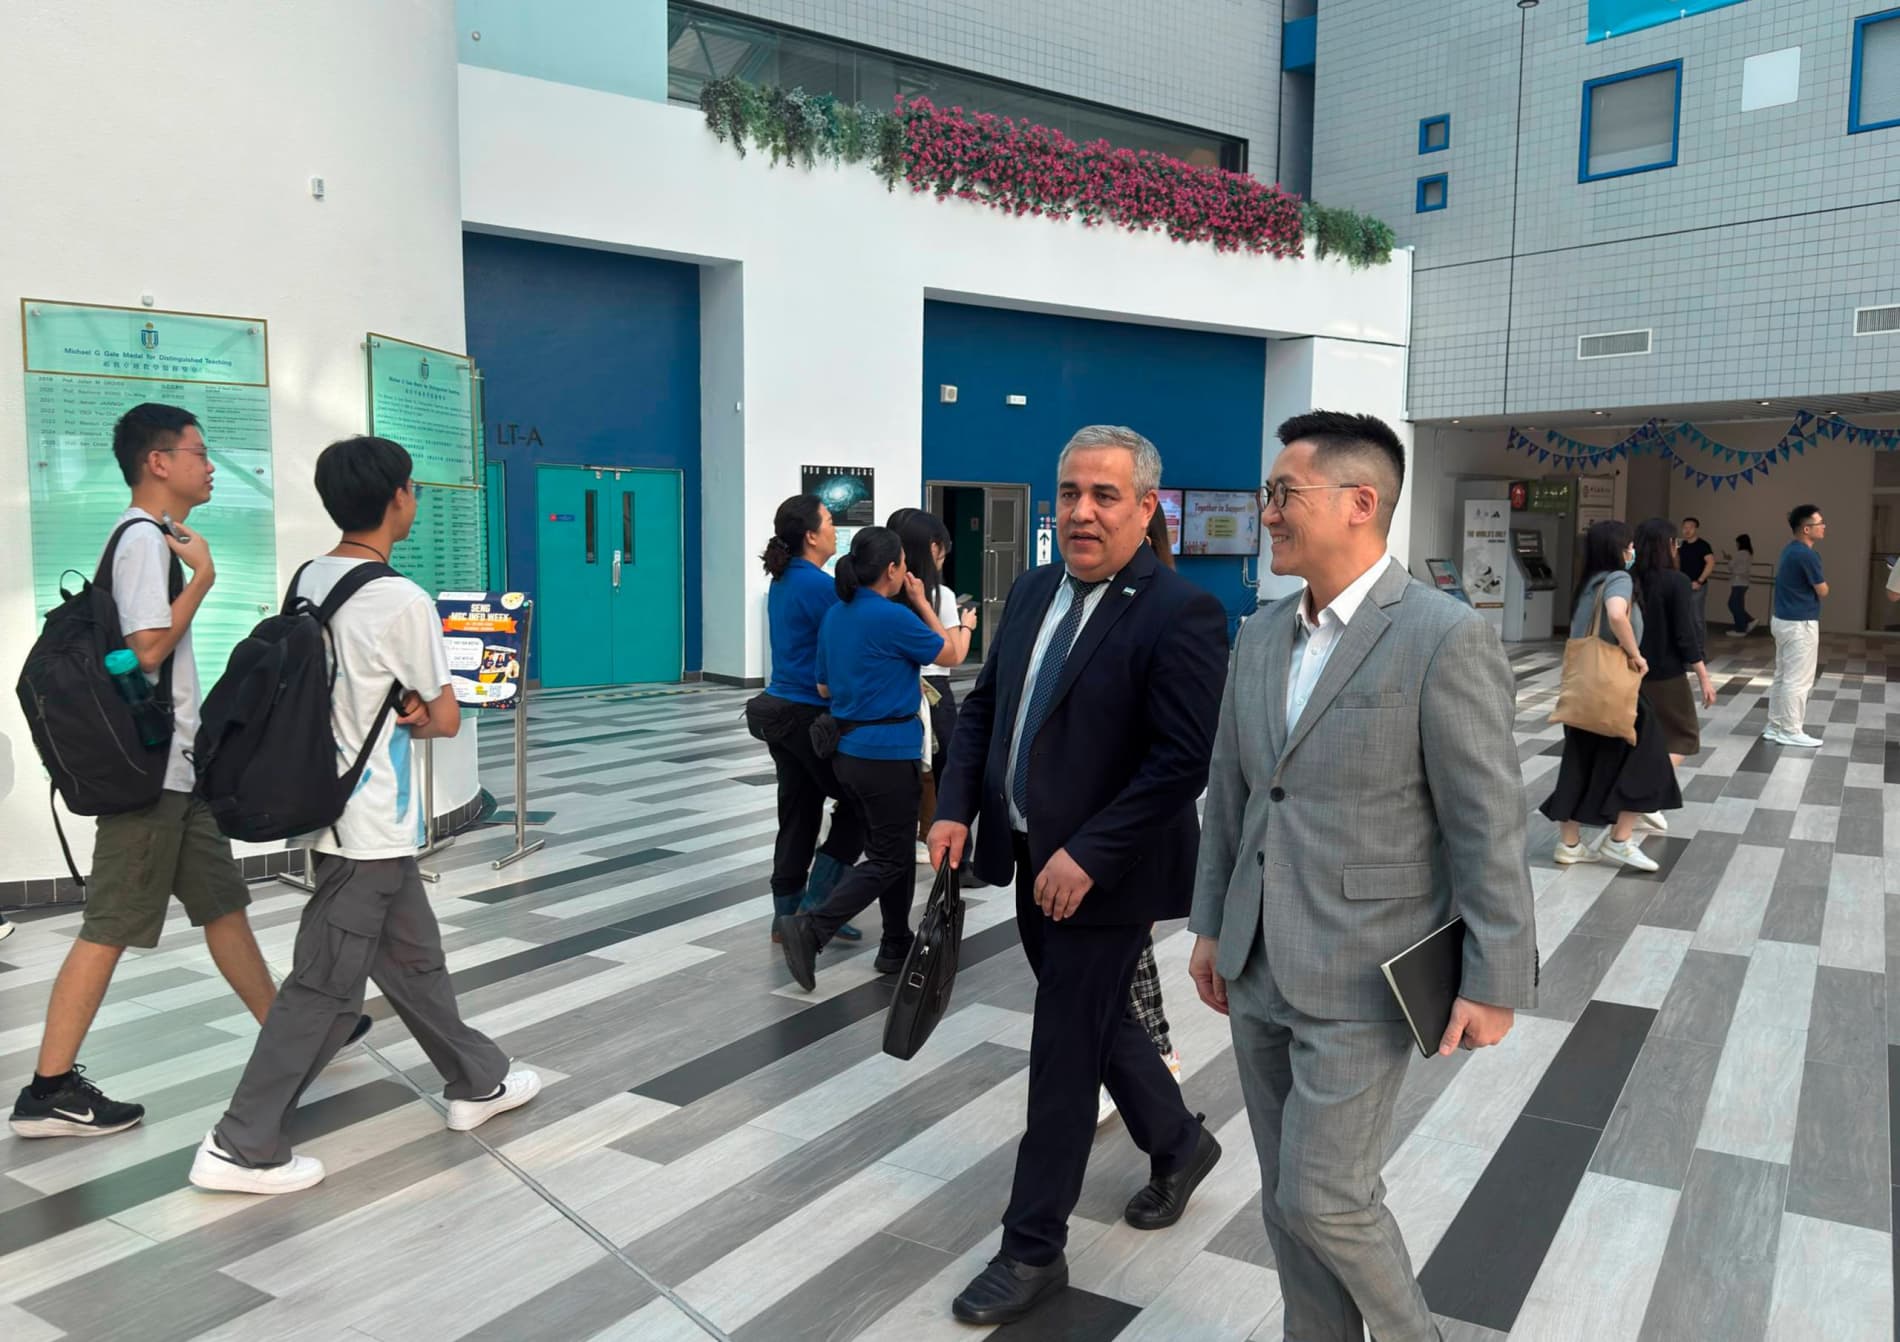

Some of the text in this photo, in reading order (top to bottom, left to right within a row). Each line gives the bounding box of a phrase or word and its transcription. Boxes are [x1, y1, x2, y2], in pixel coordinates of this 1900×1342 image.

[64, 347, 91, 356] Michael
[159, 355, 202, 364] Distinguished
[205, 357, 232, 367] Teaching
[497, 423, 544, 448] LT-A
[1194, 503, 1217, 515] Together
